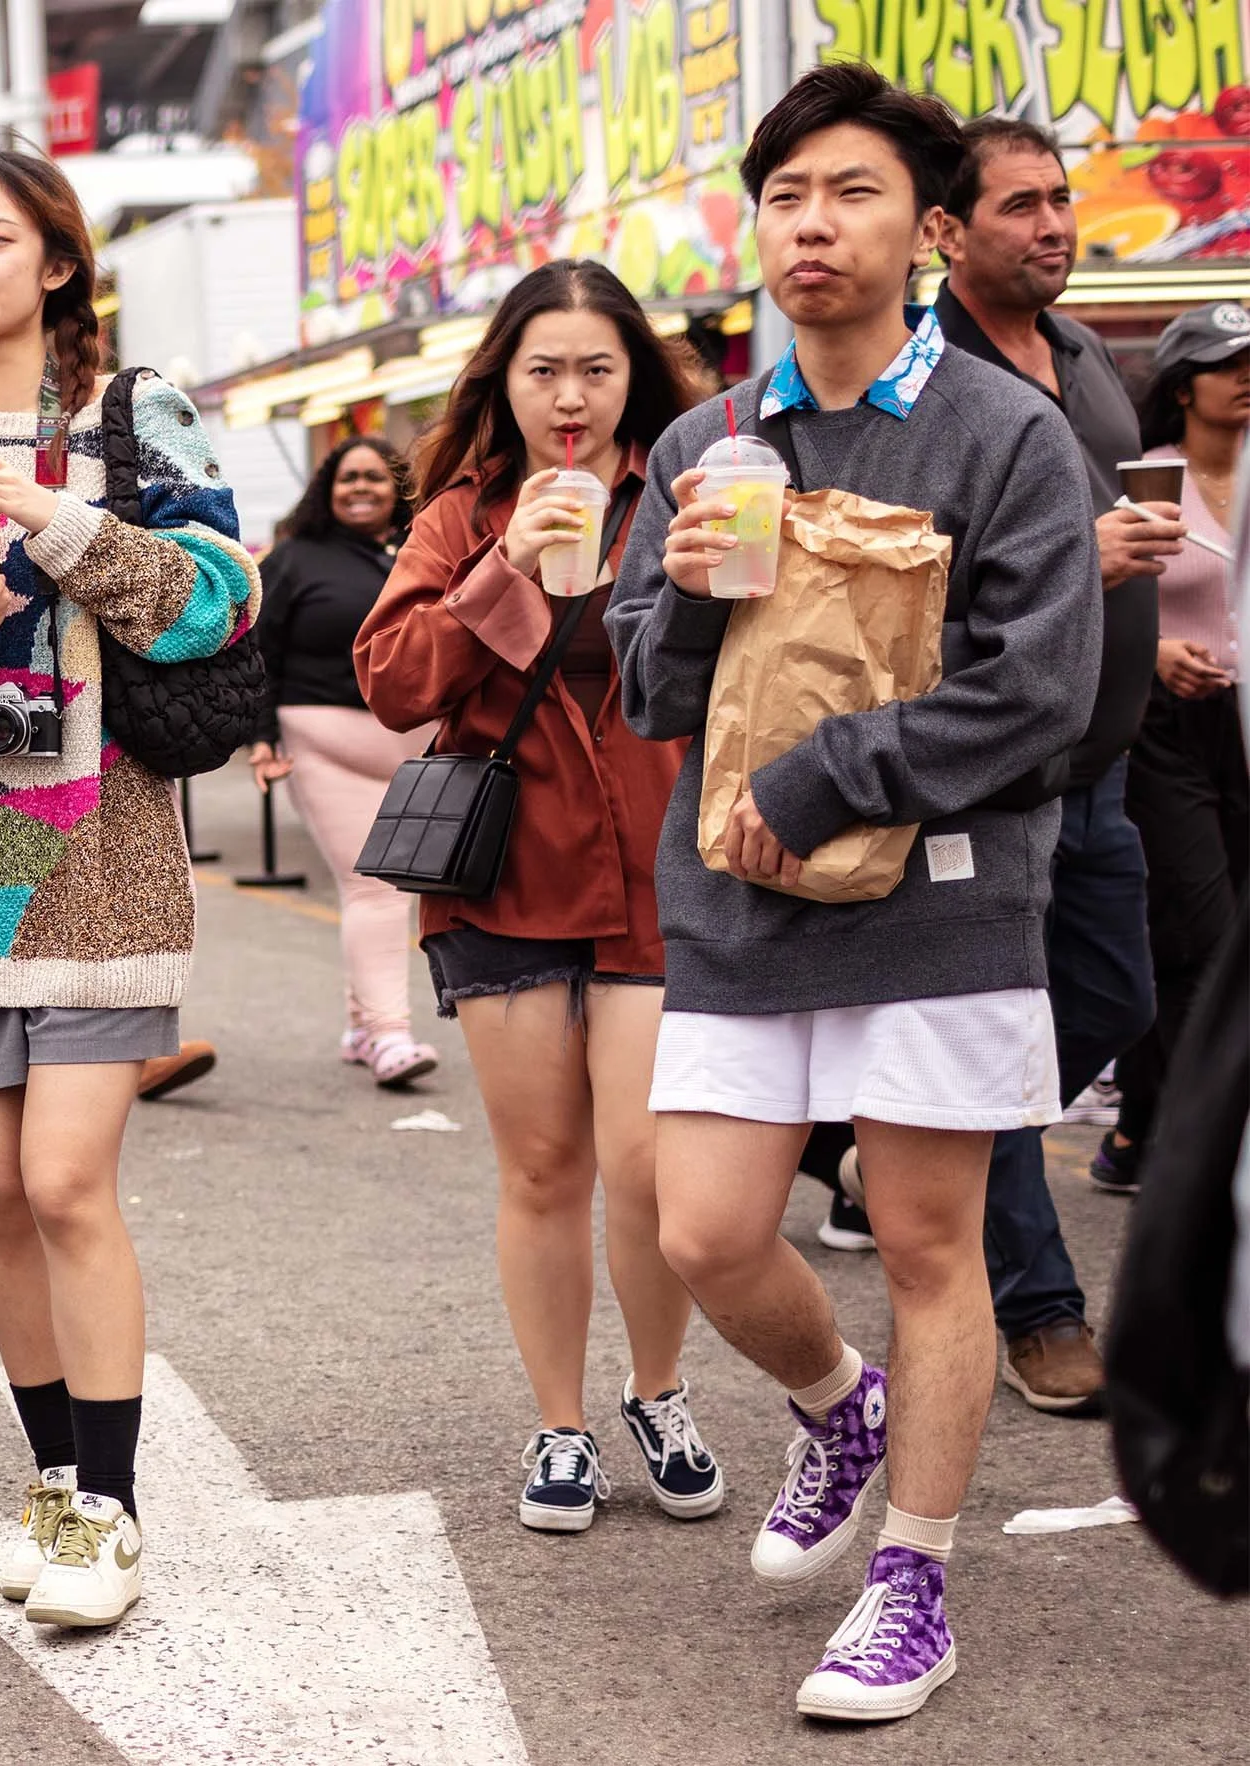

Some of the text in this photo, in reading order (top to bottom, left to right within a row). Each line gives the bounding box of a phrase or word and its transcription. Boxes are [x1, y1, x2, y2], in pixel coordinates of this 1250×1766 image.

[338, 103, 446, 268] SUPER
[453, 25, 585, 229] SLUSH
[597, 0, 682, 188] LAB
